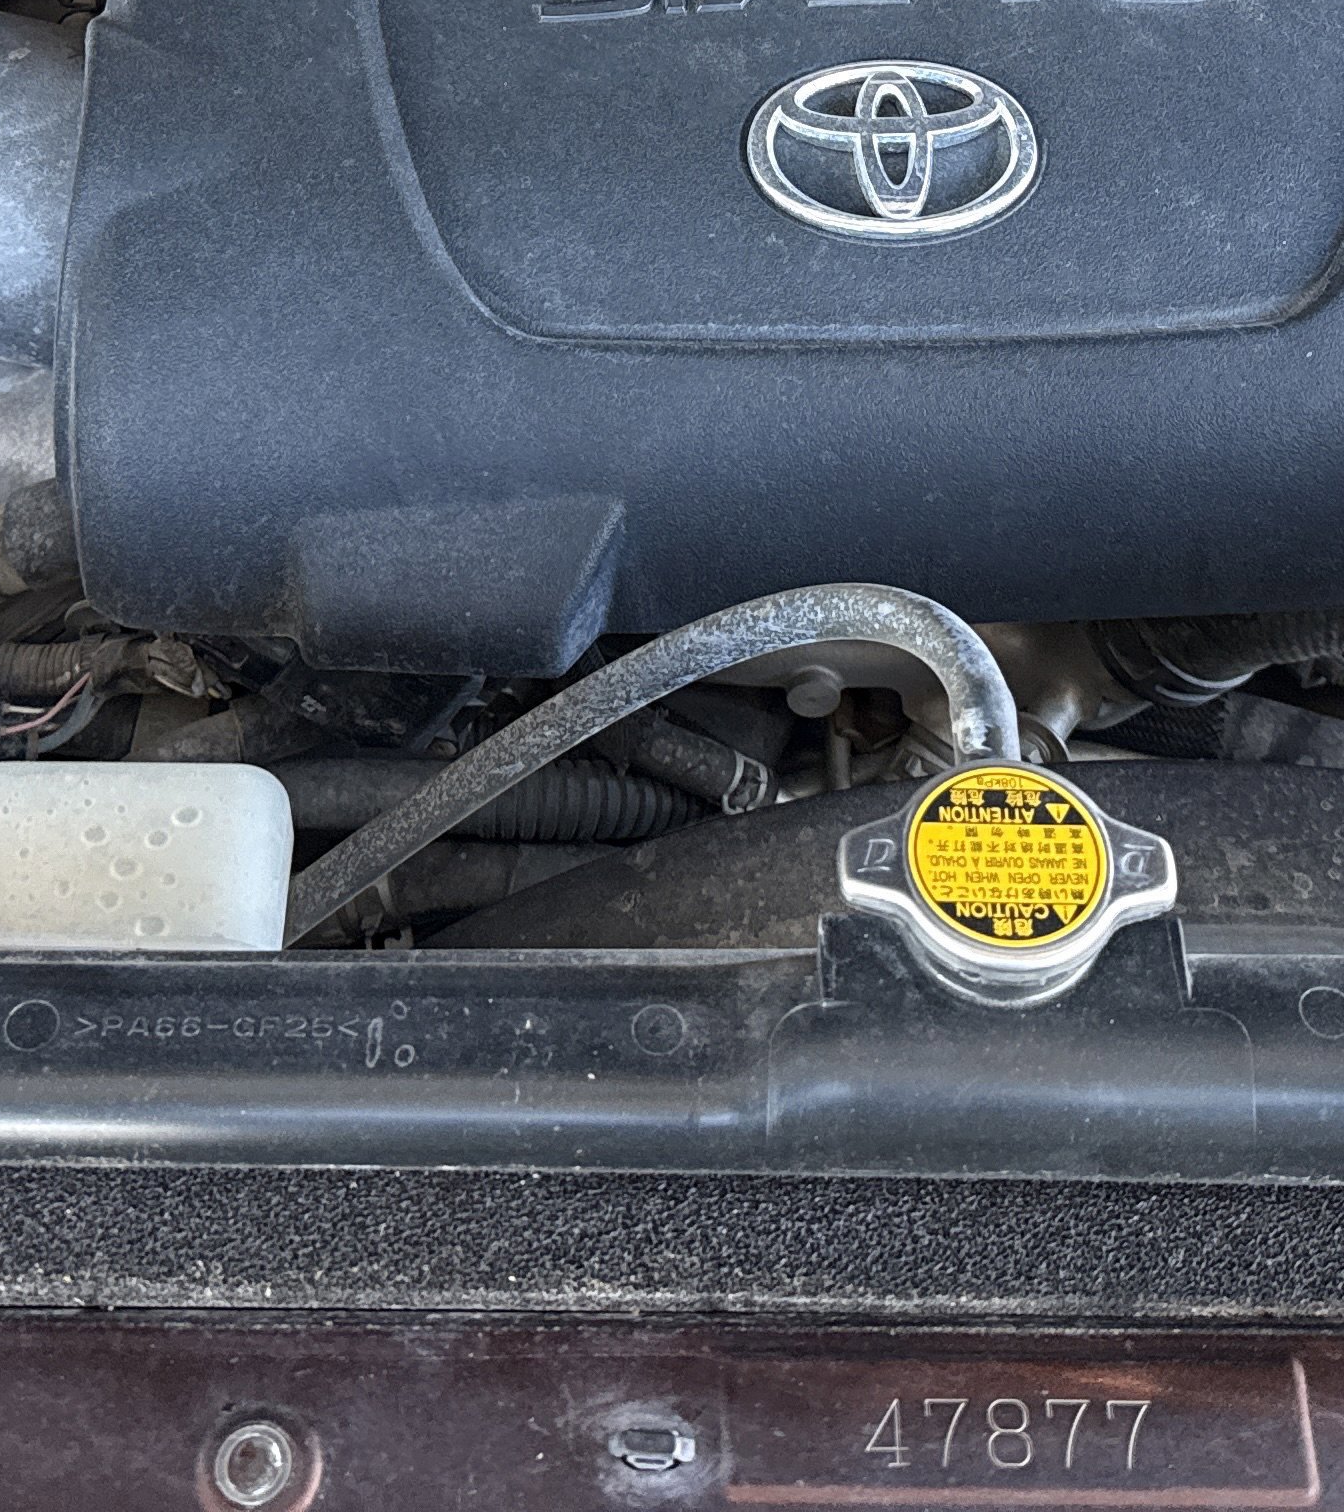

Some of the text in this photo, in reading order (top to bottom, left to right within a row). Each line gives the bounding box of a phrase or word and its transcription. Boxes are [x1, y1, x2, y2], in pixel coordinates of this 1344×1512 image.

[938, 806, 1035, 823] ATTENTION
[985, 856, 1024, 869] OUVRIR
[1029, 857, 1067, 869] JAMAIS
[1072, 857, 1087, 869] NE
[928, 870, 1089, 885] NEVER OPEN WHEN HOT.
[955, 902, 1050, 918] CAUTION
[864, 1397, 1152, 1469] 47877
